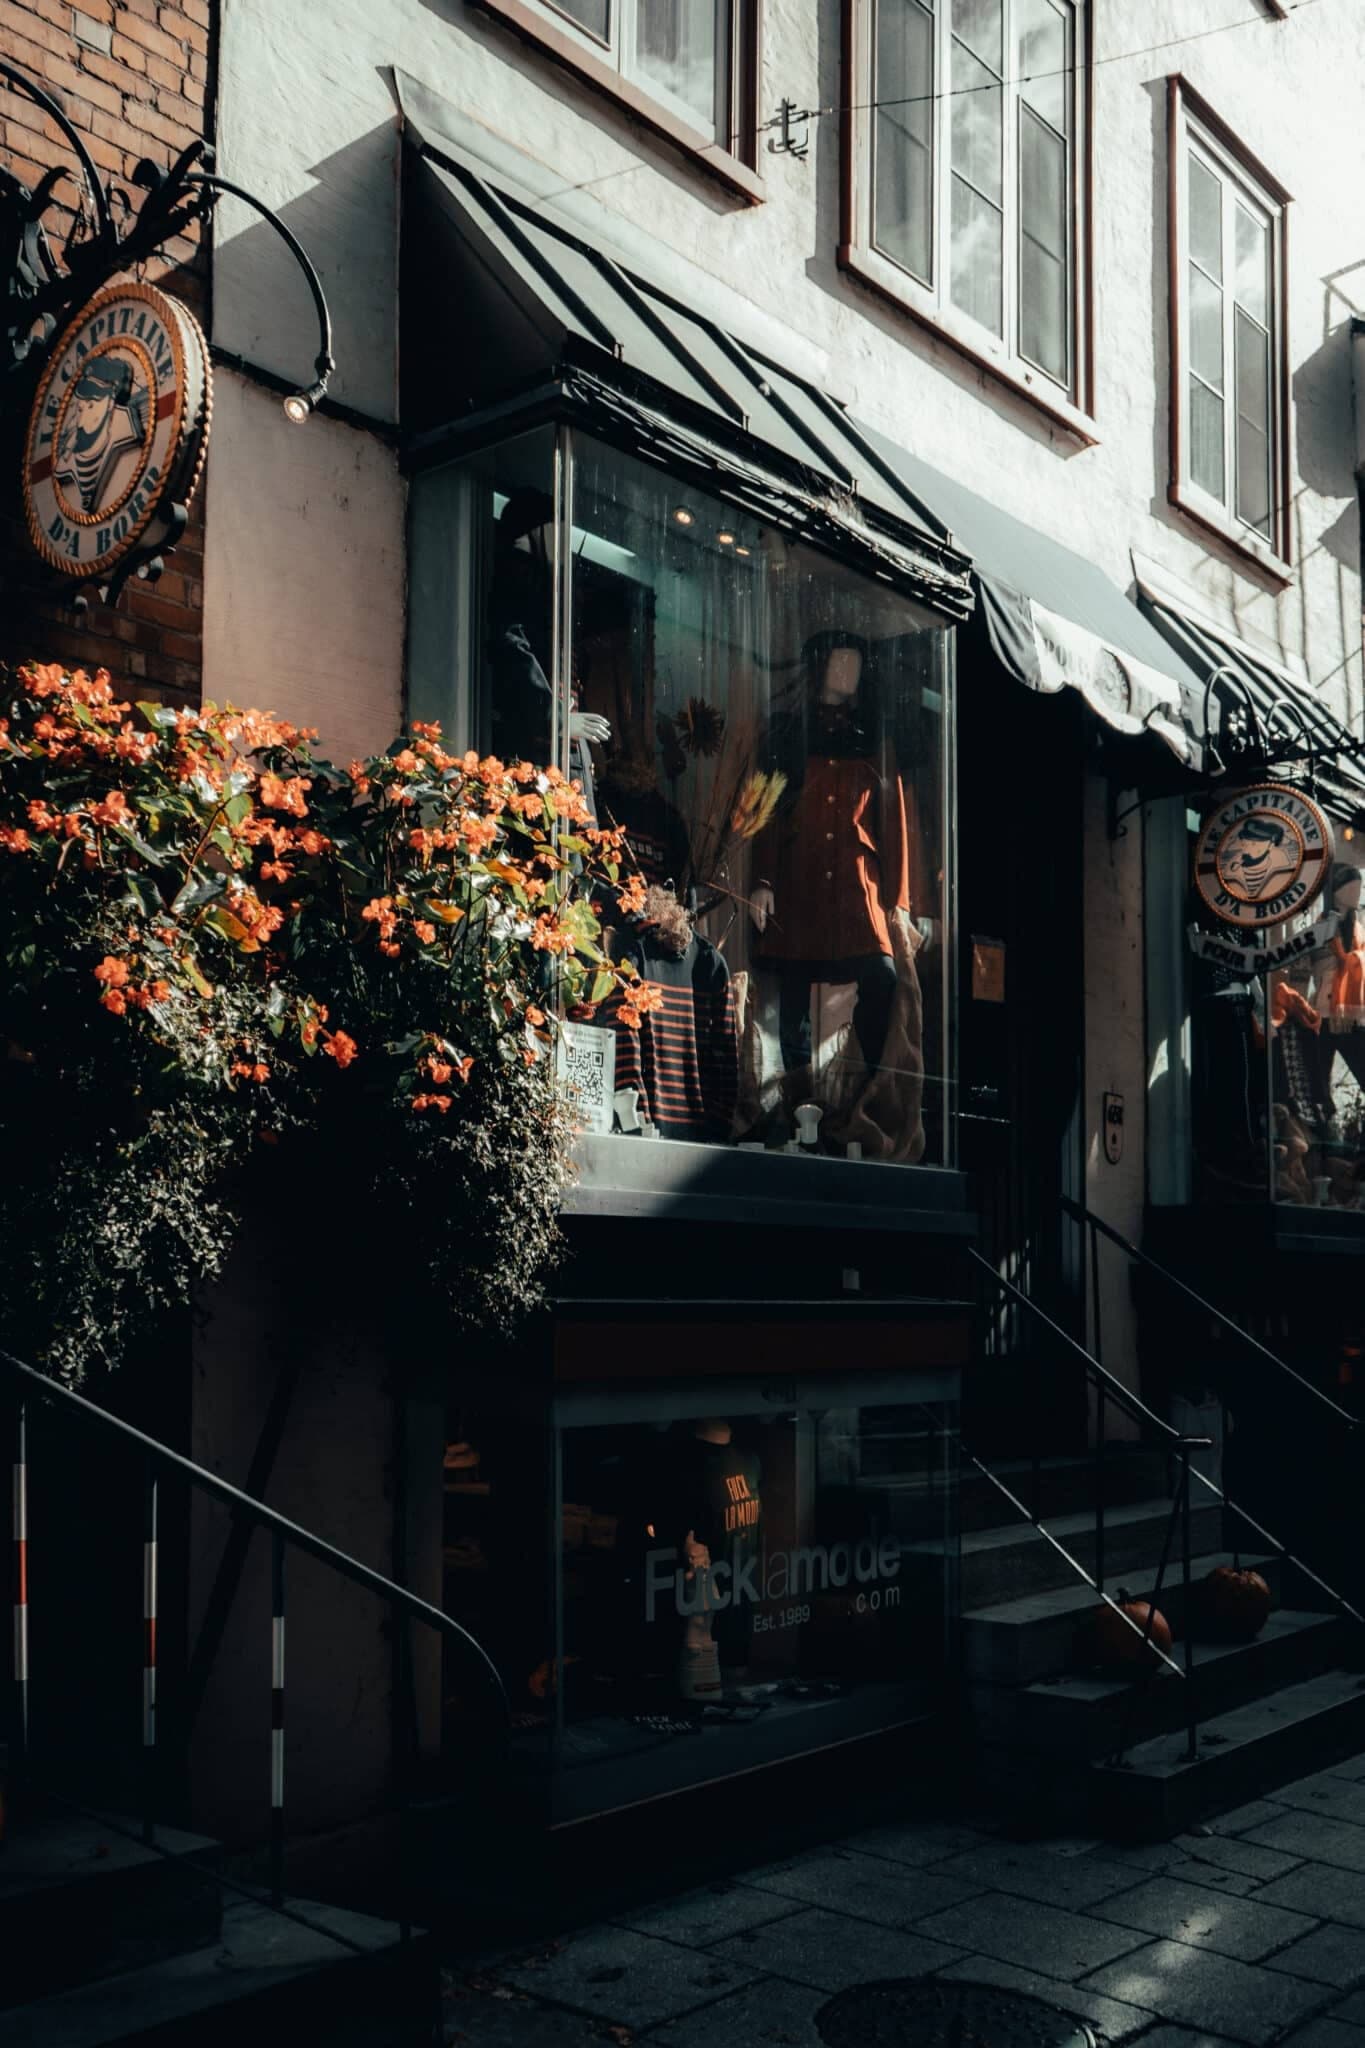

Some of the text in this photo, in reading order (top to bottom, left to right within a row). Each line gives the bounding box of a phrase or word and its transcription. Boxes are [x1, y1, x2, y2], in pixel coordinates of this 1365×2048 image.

[40, 307, 175, 444] LE CAPITAINE
[48, 467, 161, 558] D'A BORD
[1204, 794, 1319, 854] LE CAPITAINE
[1214, 882, 1307, 919] D'A BORD
[1254, 930, 1317, 969] DAMES
[753, 1604, 811, 1633] Est. 1989
